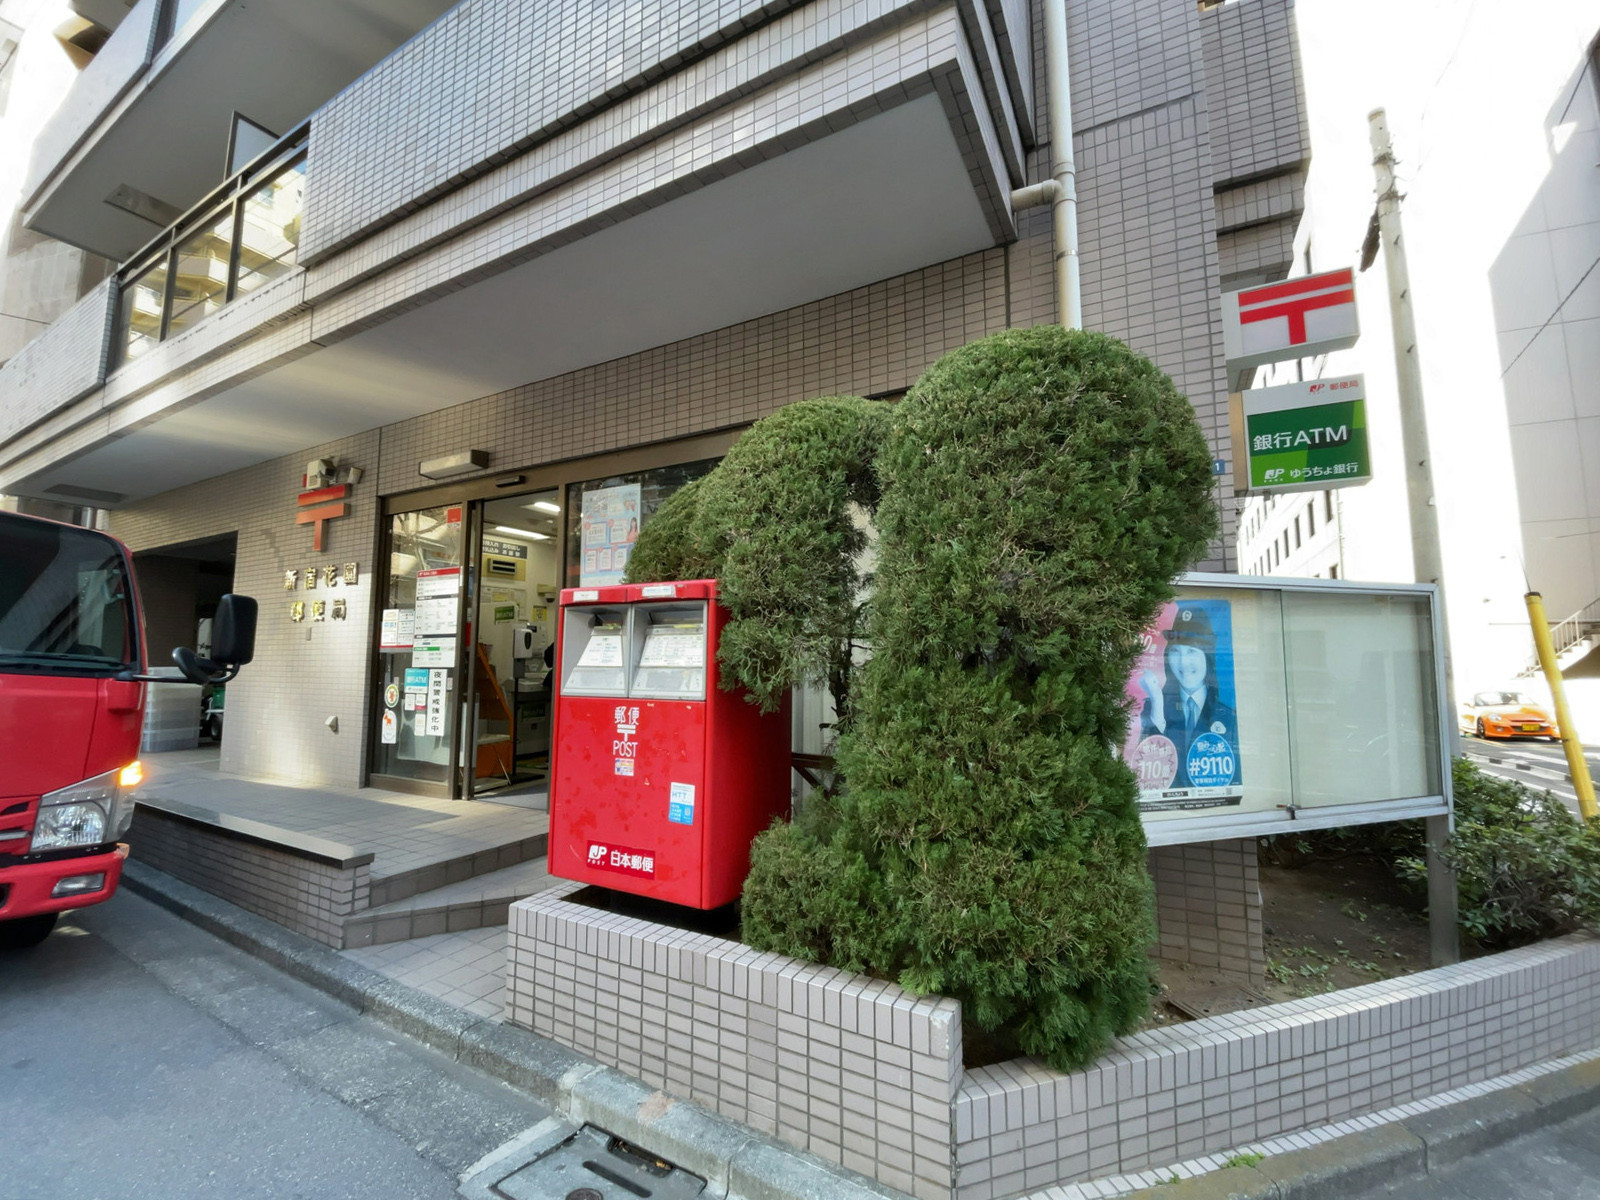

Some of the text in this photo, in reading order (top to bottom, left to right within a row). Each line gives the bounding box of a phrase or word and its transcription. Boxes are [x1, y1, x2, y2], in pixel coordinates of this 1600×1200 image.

[1329, 380, 1359, 391] 郵便局
[1253, 425, 1348, 452] 銀行ATM
[1214, 462, 1220, 472] 1
[1290, 462, 1359, 479] ゆうちょ銀行
[284, 562, 357, 591] 新宿花園
[290, 598, 347, 623] 郵便局
[431, 671, 442, 732] 夜間警戒強化中
[614, 705, 640, 726] 郵便
[613, 741, 638, 758] POST
[1189, 756, 1233, 777] #9110
[610, 849, 654, 874] 日本郵便
